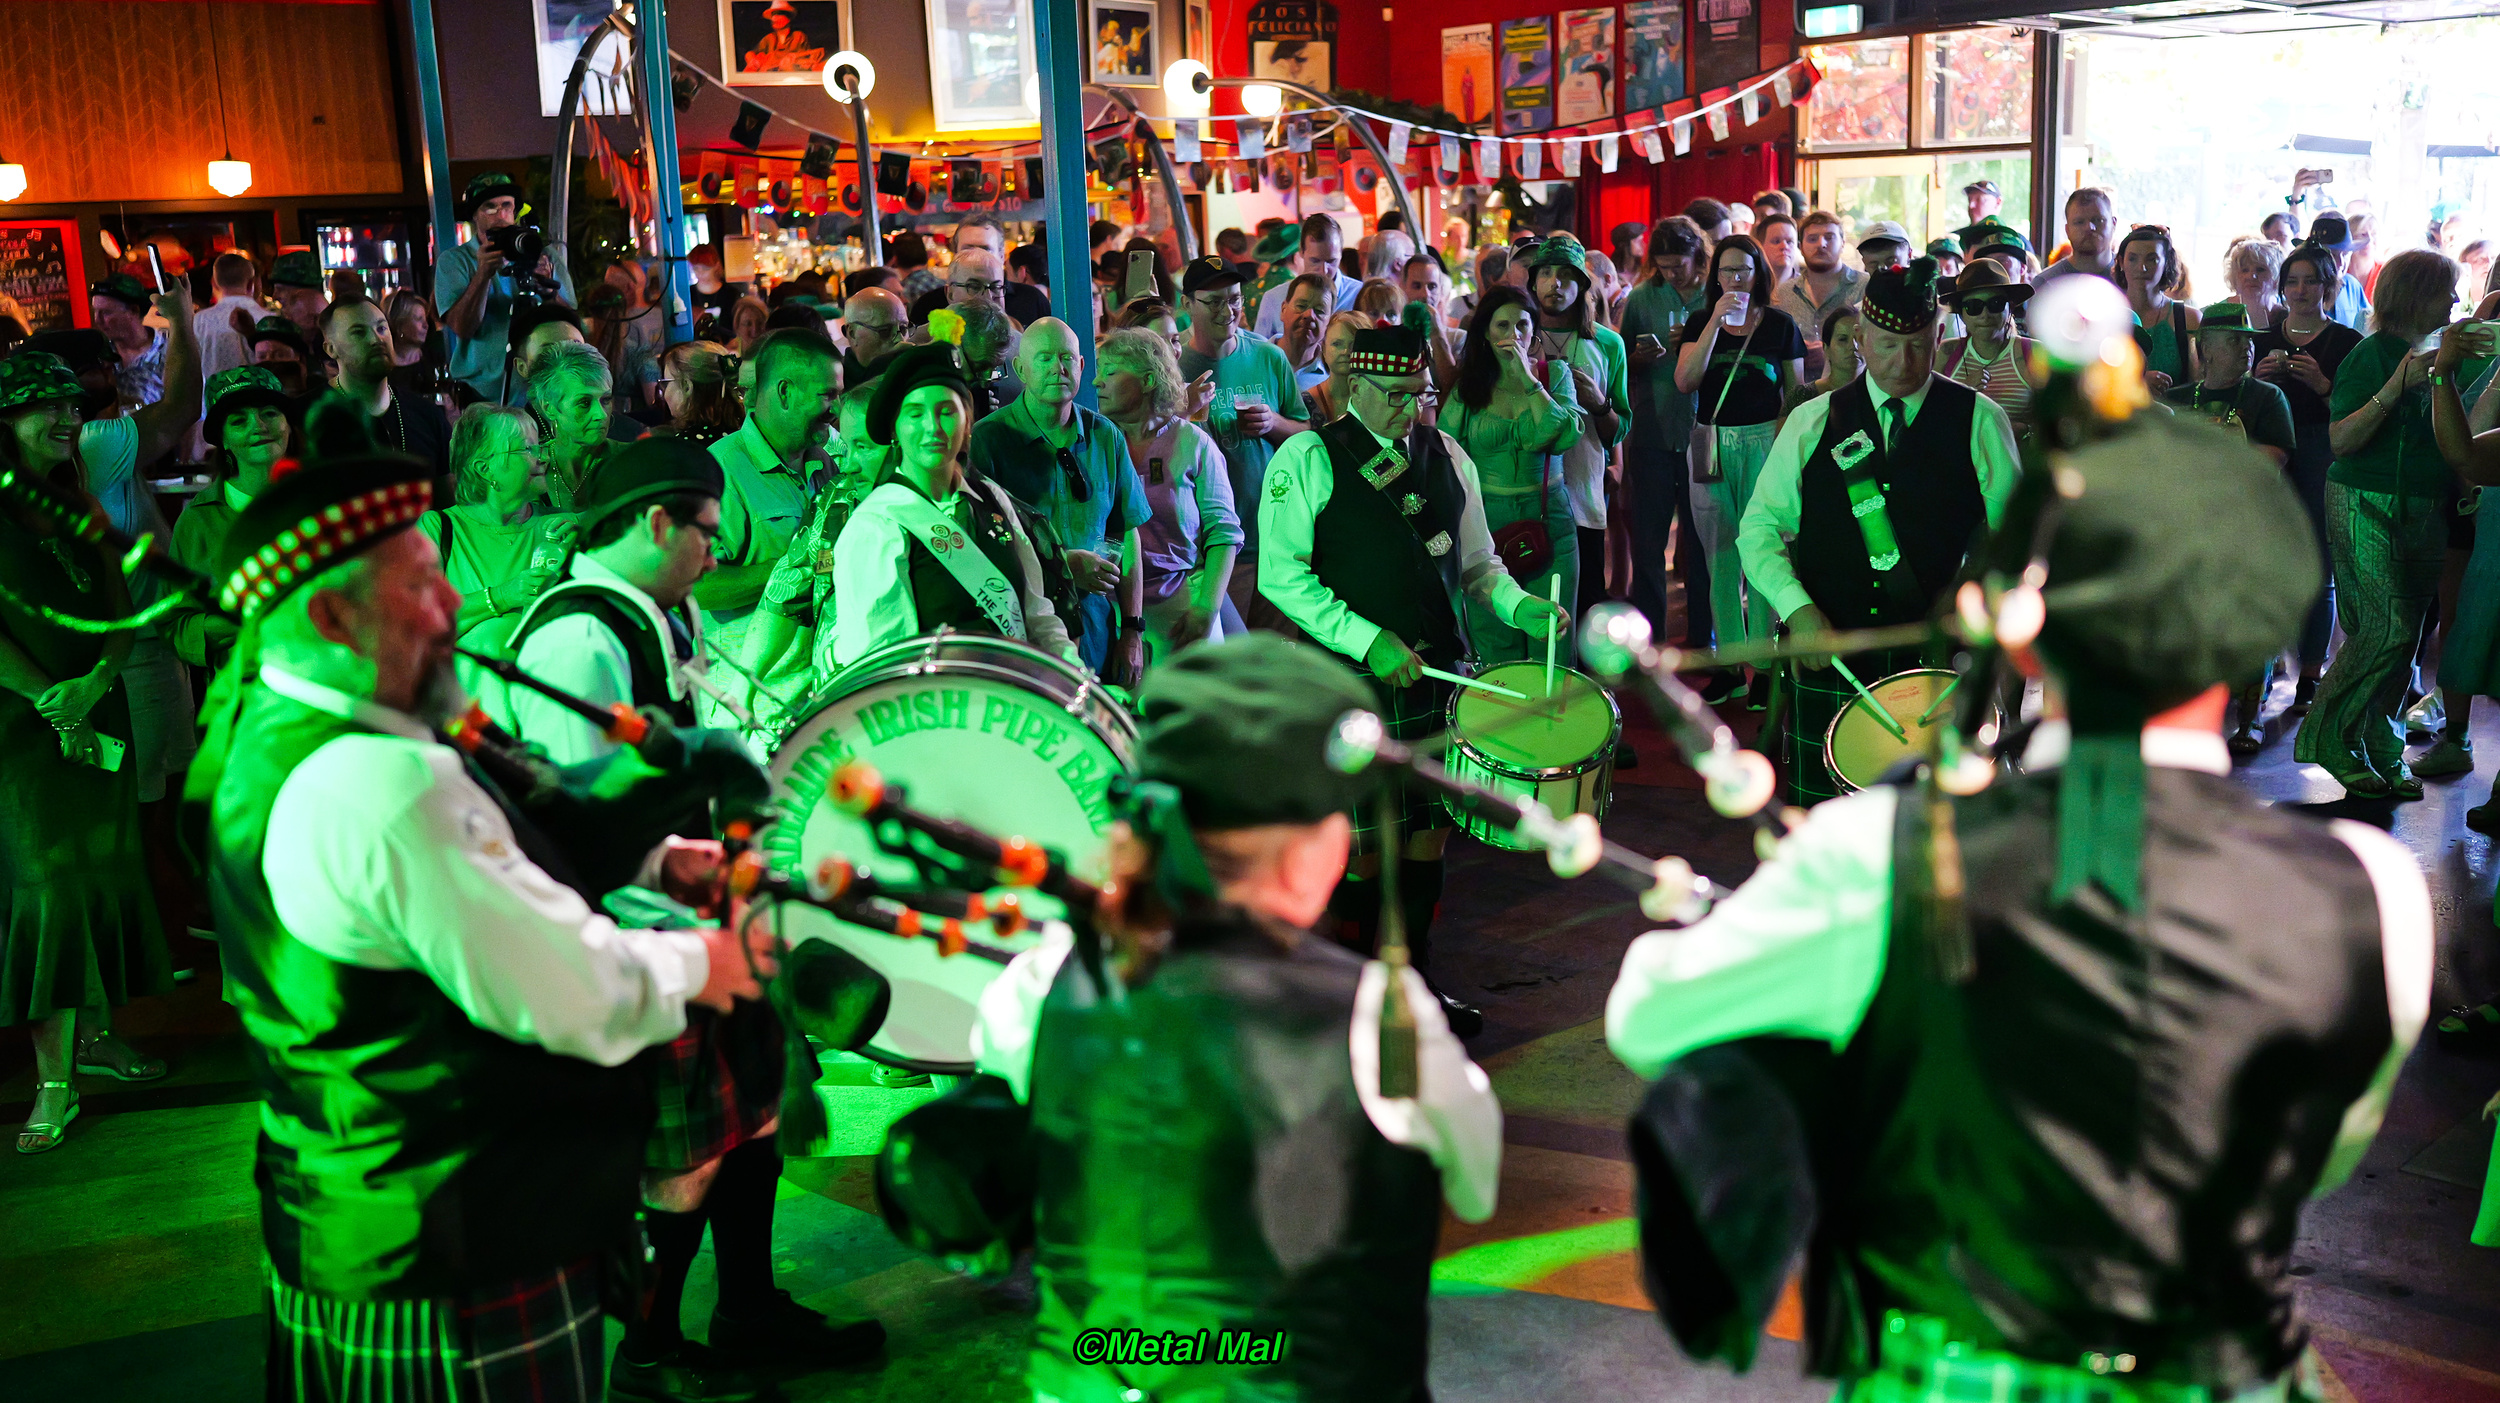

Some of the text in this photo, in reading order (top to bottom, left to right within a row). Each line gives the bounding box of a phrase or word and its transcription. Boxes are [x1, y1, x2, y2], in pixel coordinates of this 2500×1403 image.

[977, 588, 1016, 638] THE ADE
[855, 690, 970, 747] IRISH
[980, 695, 1068, 762] PIPE
